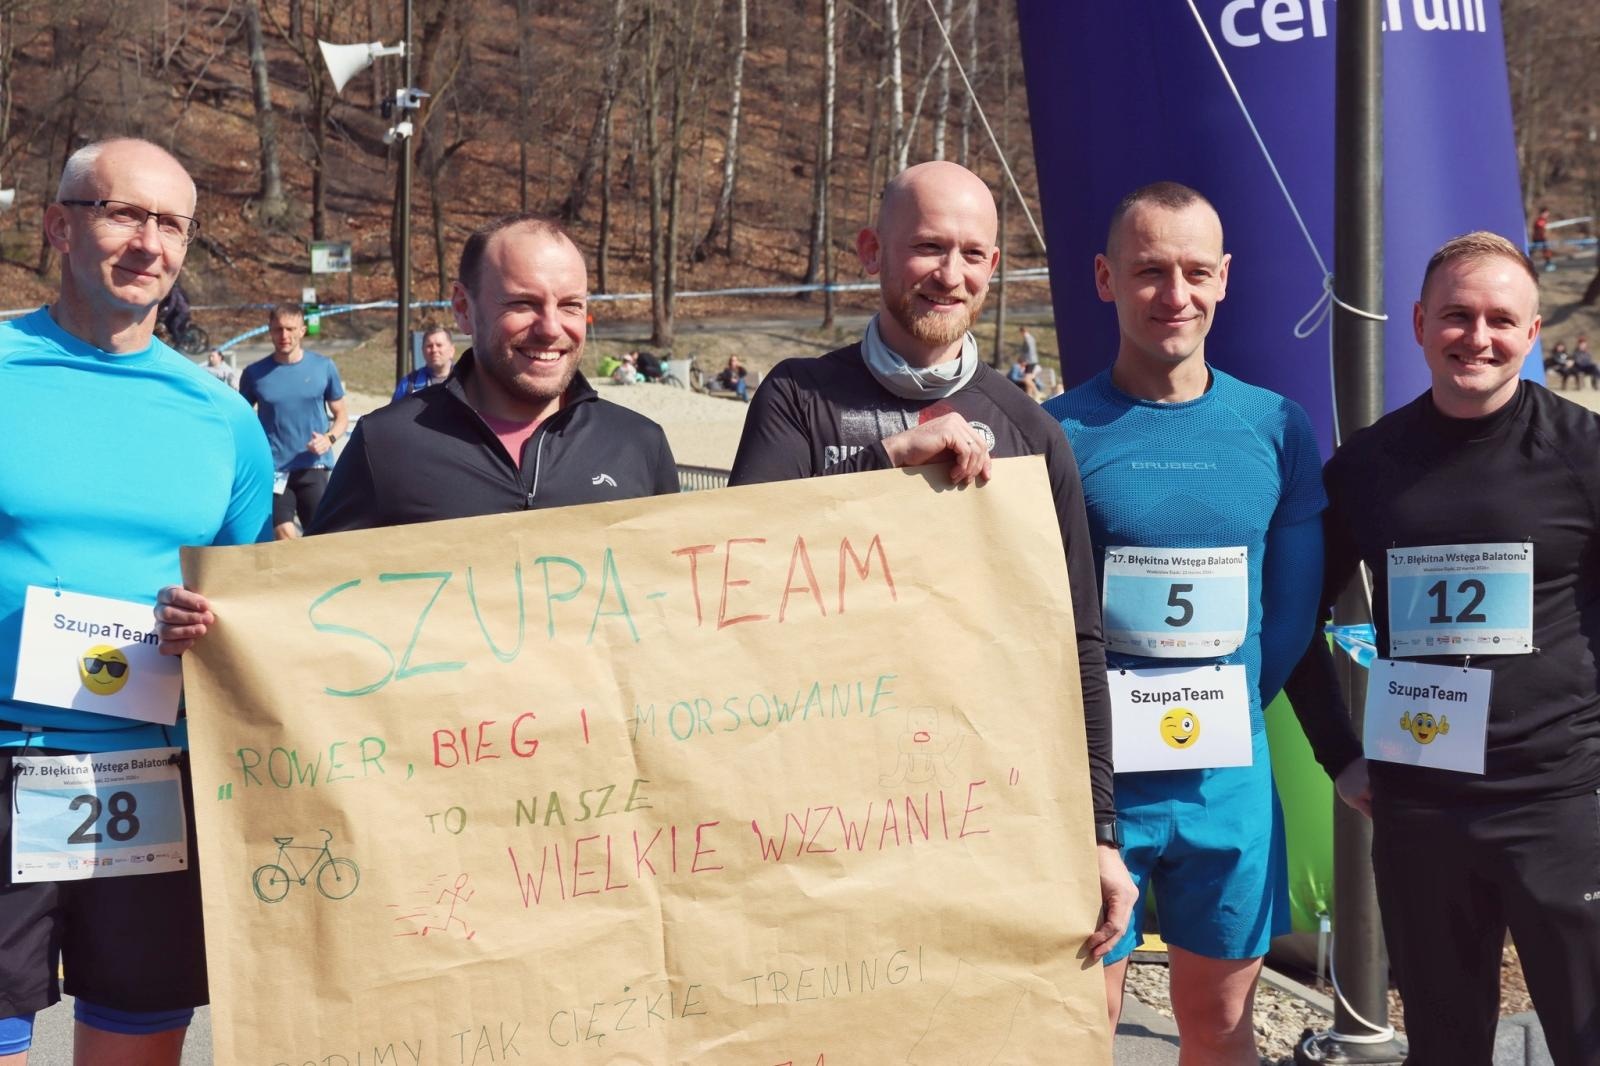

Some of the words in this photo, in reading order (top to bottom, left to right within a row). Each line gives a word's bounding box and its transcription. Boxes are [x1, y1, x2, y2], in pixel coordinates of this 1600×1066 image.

[1220, 0, 1486, 48] cerum
[1112, 554, 1126, 564] 17.
[1128, 555, 1169, 566] Błękitna
[1171, 556, 1206, 567] Wstęga
[1207, 556, 1243, 565] Balatonu
[1394, 556, 1406, 565] 17.
[1407, 554, 1444, 566] Błękitna
[1445, 552, 1480, 563] Wstęga
[1482, 551, 1527, 561] Balatonu
[309, 534, 897, 697] SZUPA-TEAM
[1164, 583, 1194, 627] 5
[1427, 578, 1487, 624] 12
[53, 613, 159, 645] SzupaTeam
[1130, 687, 1224, 705] SzupaTeam
[1388, 680, 1468, 702] SzupaTeam
[432, 711, 539, 769] BIEG
[633, 674, 899, 742] MORSOWANIE
[23, 766, 38, 777] 17.
[41, 766, 88, 778] Błękitna
[91, 761, 129, 774] Wstęga
[131, 758, 172, 770] Balaton
[67, 791, 140, 844] 28
[425, 806, 467, 835] TO
[515, 778, 654, 827] NASZE
[508, 820, 725, 908] WIELKIE
[450, 1022, 521, 1066] TAK
[548, 984, 708, 1047] CIĘŻKIE
[742, 945, 923, 1008] TRENINGI
